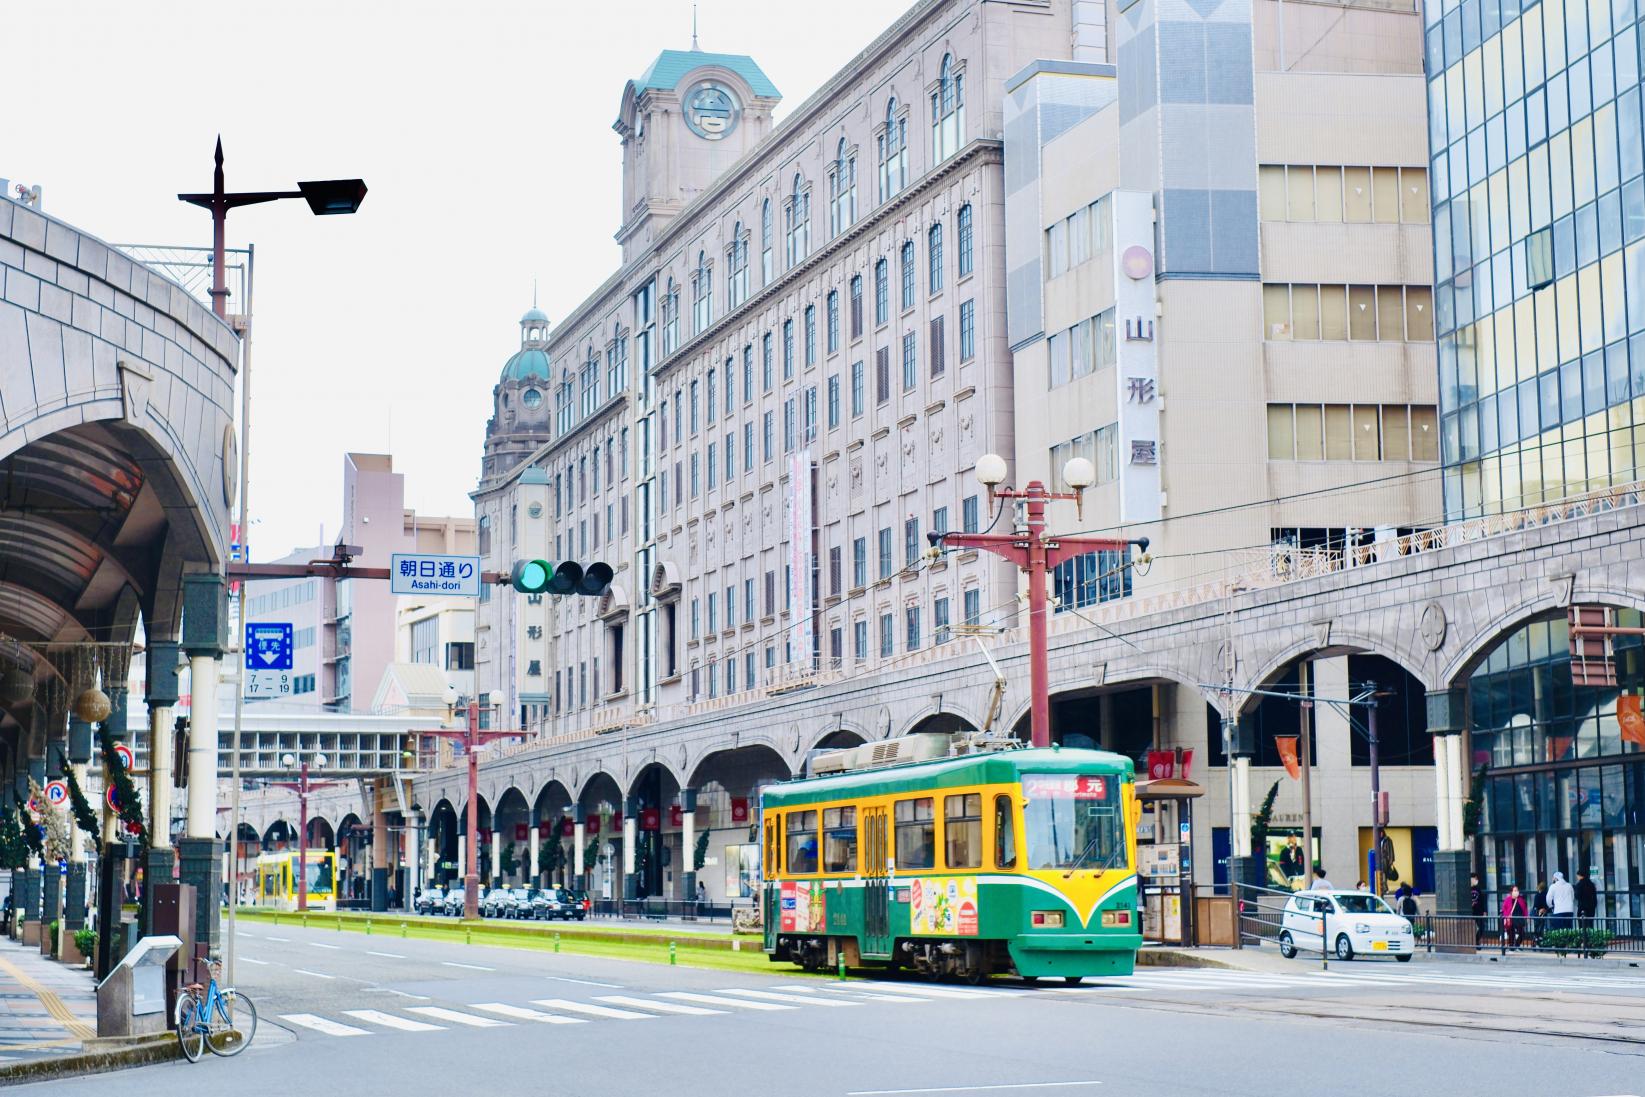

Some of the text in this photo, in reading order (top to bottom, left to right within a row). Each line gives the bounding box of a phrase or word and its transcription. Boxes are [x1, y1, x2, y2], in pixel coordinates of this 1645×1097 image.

[1124, 316, 1157, 466] 山形屋
[400, 560, 473, 579] 朝日通り
[411, 580, 461, 590] Asahi-dori
[527, 593, 543, 676] 山形屋
[258, 640, 281, 651] 優先
[250, 675, 257, 683] 7
[281, 675, 288, 683] 9
[249, 684, 259, 693] 17
[279, 684, 290, 693] 19
[1271, 813, 1304, 823] AUREN
